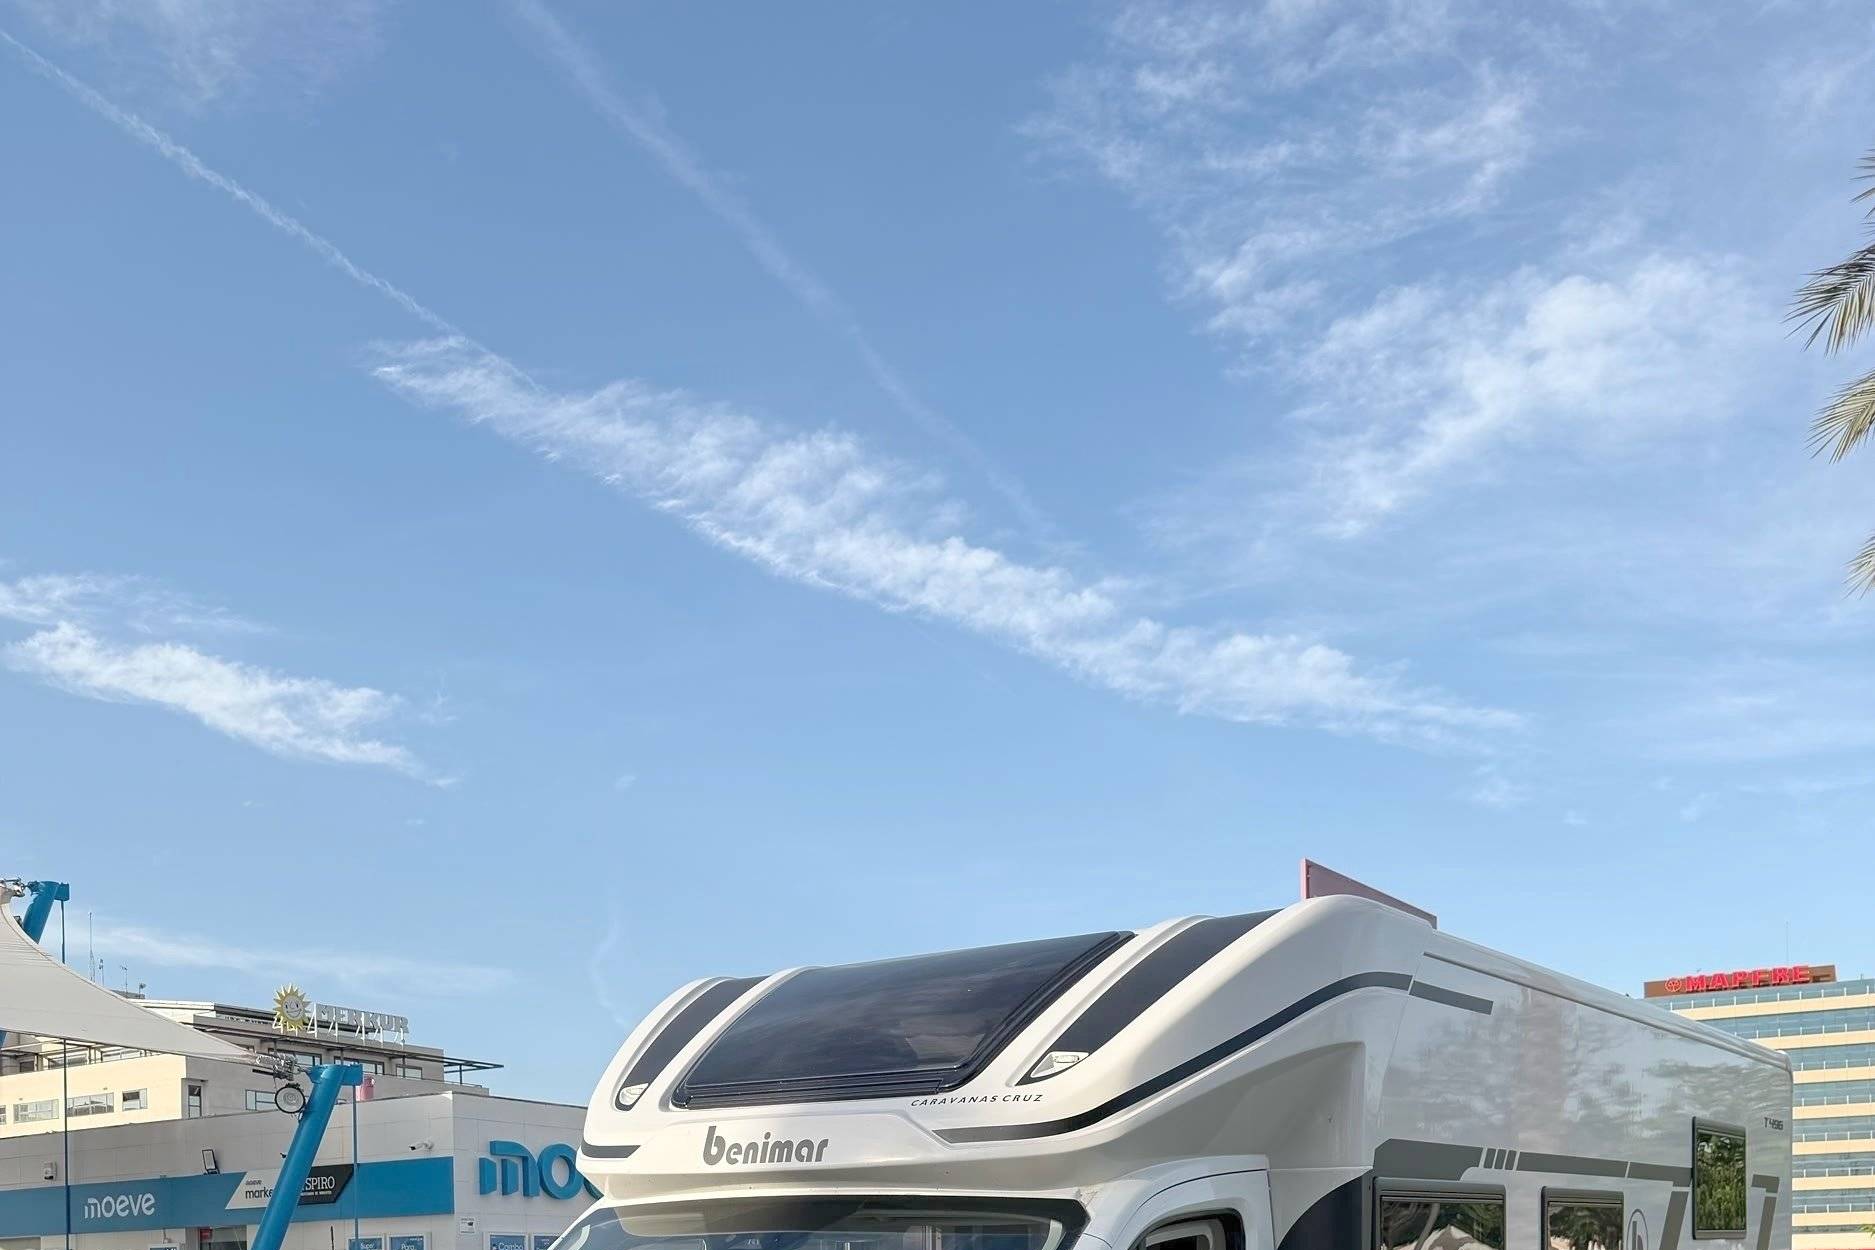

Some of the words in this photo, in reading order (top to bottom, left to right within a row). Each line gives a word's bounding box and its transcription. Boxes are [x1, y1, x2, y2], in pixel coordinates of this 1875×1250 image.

[1685, 965, 1810, 992] MAPFRE
[315, 1003, 409, 1033] MERKUR
[910, 1095, 998, 1107] CARAVANAS
[1002, 1094, 1043, 1102] CRUZ
[703, 1125, 829, 1166] benimar
[478, 1140, 604, 1200] mo
[245, 1187, 273, 1199] marke
[302, 1176, 336, 1191] SPIRO
[84, 1193, 156, 1219] moeve
